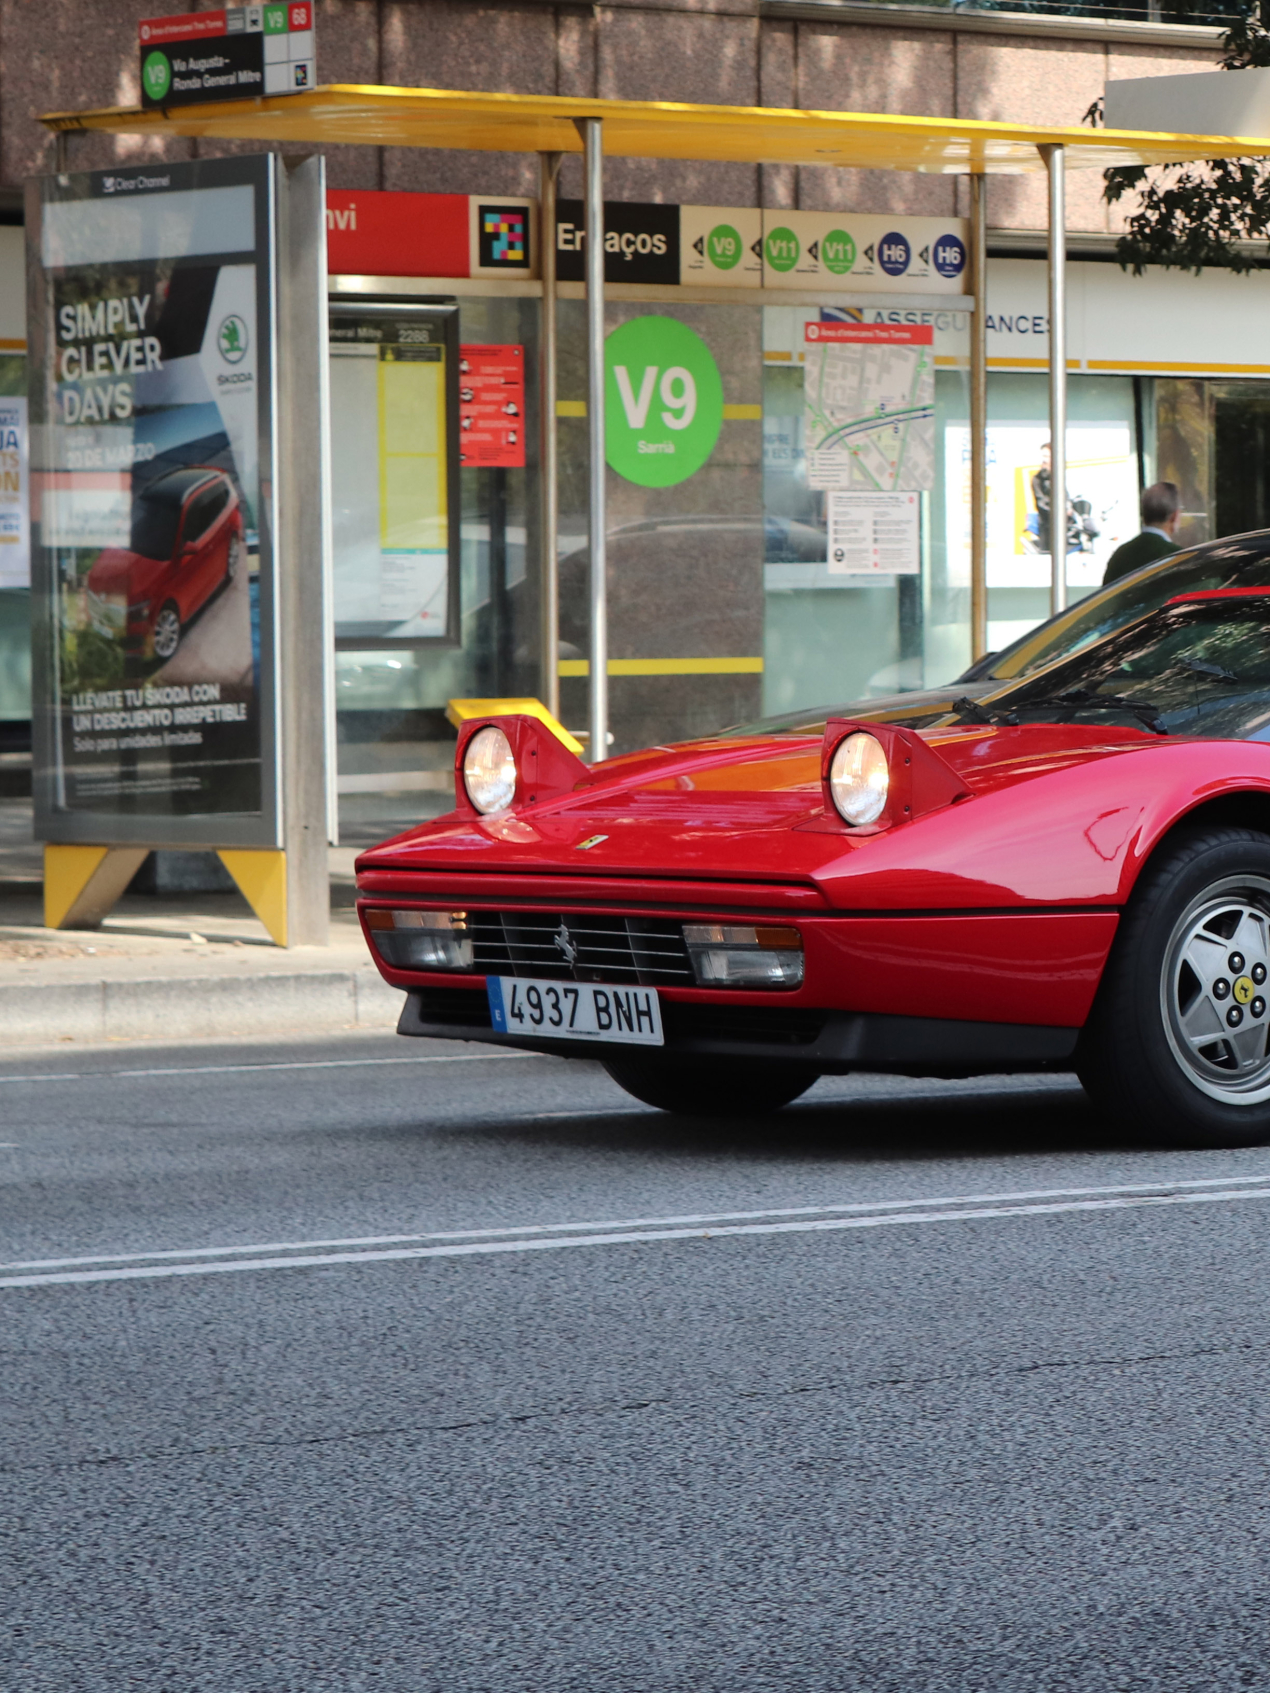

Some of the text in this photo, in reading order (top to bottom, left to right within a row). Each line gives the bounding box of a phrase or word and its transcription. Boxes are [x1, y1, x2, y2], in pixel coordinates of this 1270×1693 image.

[267, 11, 284, 28] V9
[292, 8, 307, 25] 68
[148, 64, 166, 84] V9
[172, 58, 187, 71] Via
[173, 69, 262, 90] Ronda General Mitre
[712, 236, 735, 255] V9
[768, 239, 796, 258] V11
[824, 241, 852, 260] V11
[882, 243, 906, 262] H6
[937, 246, 961, 265] H6
[60, 294, 150, 341] SIMPLY
[61, 336, 164, 382] CLEVER
[63, 382, 133, 424] DAYS
[613, 365, 697, 430] V9
[637, 440, 676, 454] Sarrià
[124, 689, 143, 708] TU
[191, 683, 221, 703] CON
[73, 702, 248, 732] UN DESCUENTO IRREPETIBLE
[97, 737, 118, 754] para
[119, 732, 163, 749] unidades
[163, 729, 204, 746] limitadas
[495, 984, 655, 1034] E 4937 BNH
